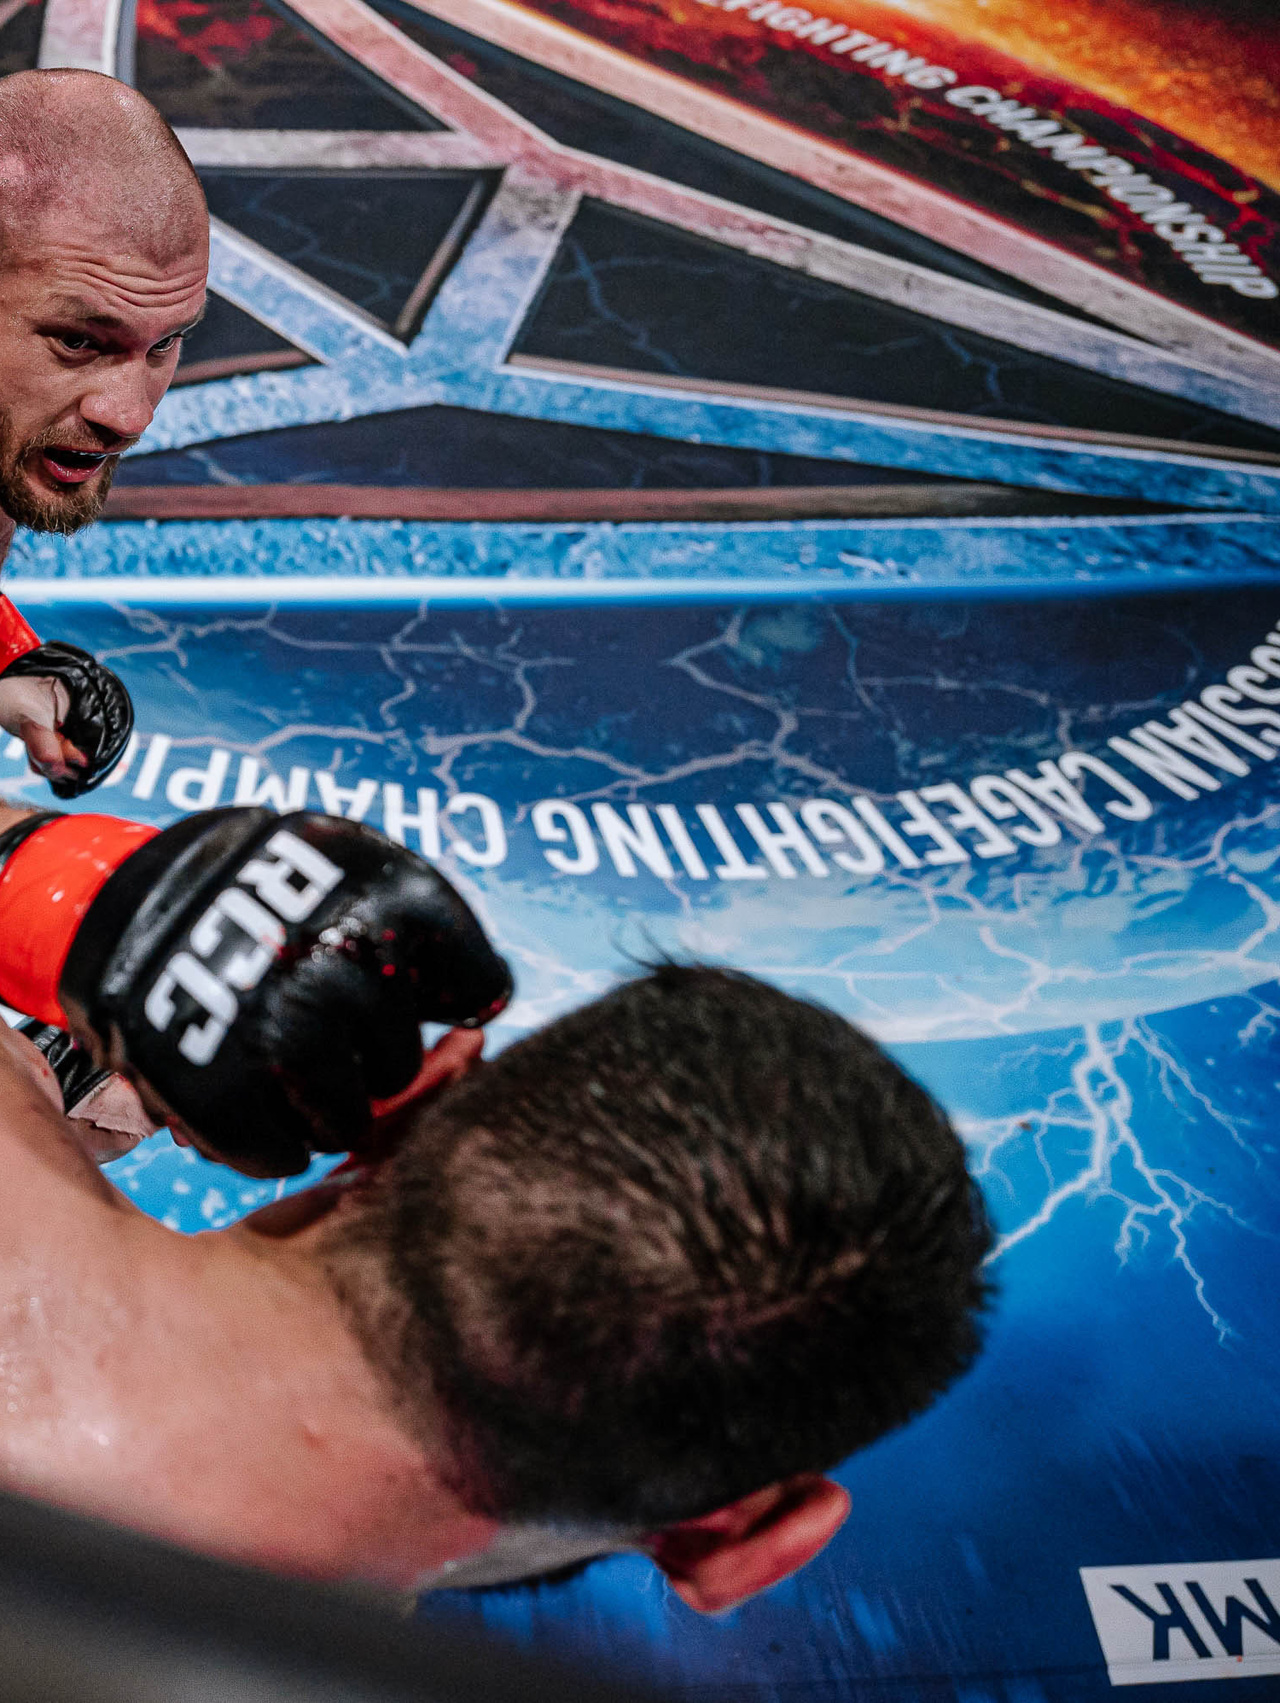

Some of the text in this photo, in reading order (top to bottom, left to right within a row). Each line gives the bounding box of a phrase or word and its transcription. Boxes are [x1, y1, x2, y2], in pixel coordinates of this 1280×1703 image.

[944, 85, 1279, 299] CHAMPIONSHIP
[533, 750, 1154, 881] CAGEFIGHTING
[145, 829, 345, 1066] RCC
